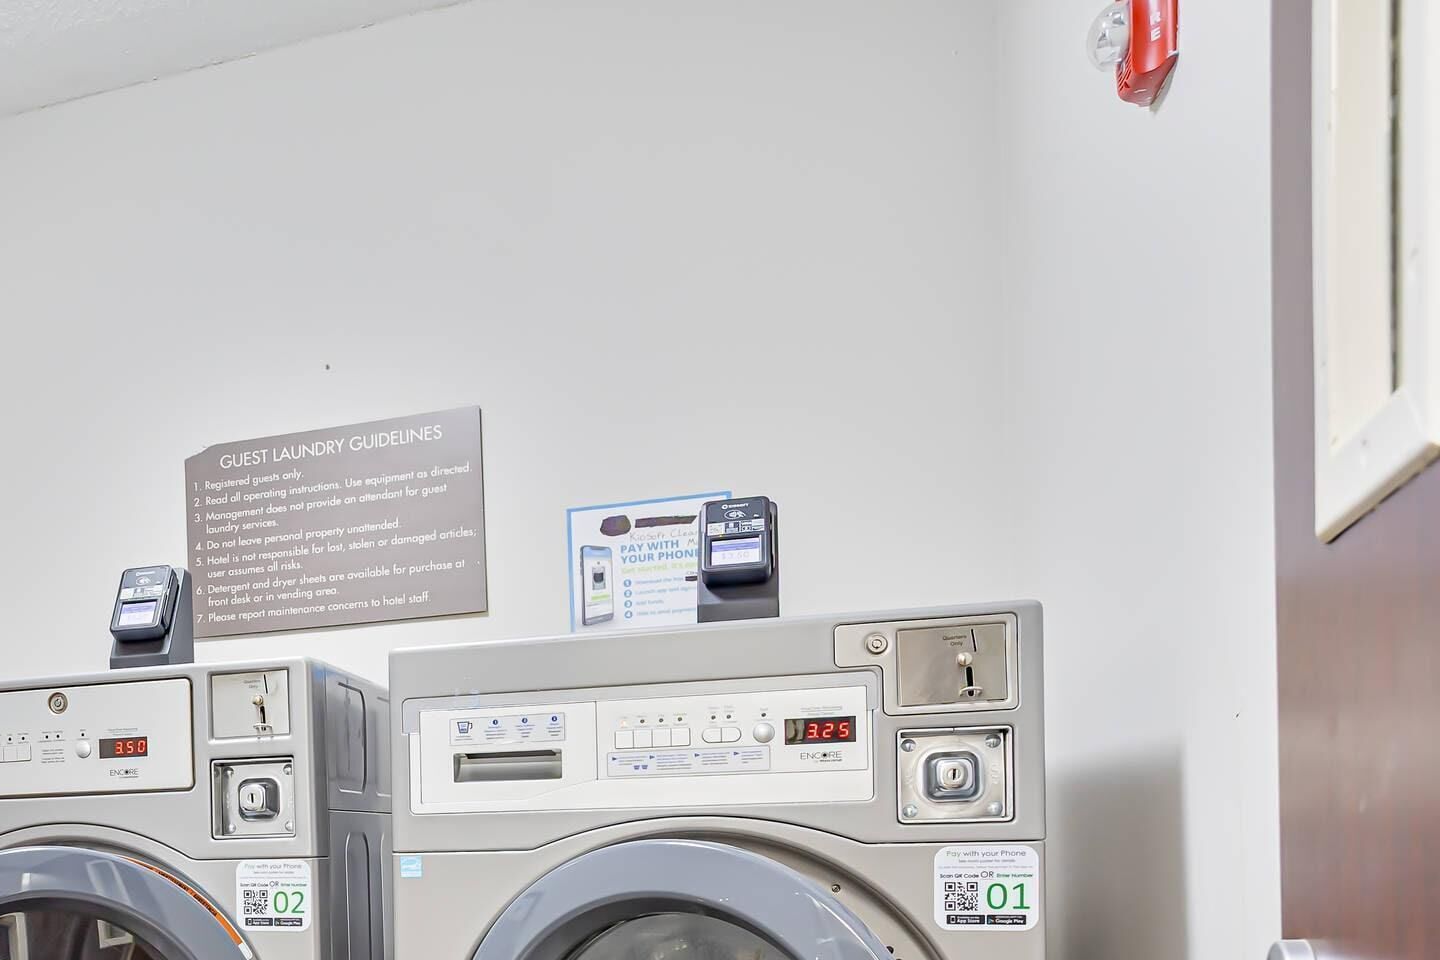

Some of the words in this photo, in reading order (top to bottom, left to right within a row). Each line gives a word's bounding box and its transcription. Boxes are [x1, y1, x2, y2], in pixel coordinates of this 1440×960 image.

[220, 449, 268, 469] GUEST
[273, 438, 345, 462] LAUNDRY
[349, 425, 443, 451] GUIDELINES
[193, 497, 202, 507] 2.
[205, 493, 228, 506] Read
[230, 491, 241, 503] all
[243, 486, 287, 502] operating
[289, 481, 342, 495] instructions.
[345, 478, 362, 488] Use
[365, 471, 414, 487] equipment
[416, 471, 428, 479] as
[430, 461, 472, 477] directed.
[194, 482, 202, 491] 1.
[205, 474, 250, 491] Registered
[252, 473, 280, 486] guests
[282, 468, 304, 481] only.
[194, 513, 203, 523] 3.
[205, 507, 264, 521] Management
[266, 503, 287, 514] does
[289, 501, 304, 511] not
[306, 496, 342, 511] provide
[344, 496, 357, 504] an
[359, 489, 403, 503] attendant
[405, 486, 419, 497] for
[421, 483, 447, 498] guest
[206, 521, 240, 535] laundry
[242, 519, 279, 530] services.
[195, 542, 204, 551] 4.
[206, 540, 220, 550] Do
[222, 538, 236, 548] not
[238, 536, 262, 546] leave
[264, 529, 303, 546] personal
[305, 526, 344, 541] property
[196, 557, 204, 567] 5.
[207, 553, 230, 566] Hotel
[232, 554, 240, 563] is
[242, 552, 256, 561] not
[258, 545, 309, 561] responsible
[311, 543, 324, 554] for
[327, 541, 346, 552] lost,
[348, 538, 375, 550] stolen
[377, 538, 389, 546] or
[391, 530, 437, 545] damaged
[439, 526, 477, 540] articles;
[620, 543, 644, 554] PAY
[647, 540, 679, 551] WITH
[207, 569, 226, 578] user
[228, 565, 265, 576] assumes
[267, 561, 278, 572] all
[280, 559, 303, 571] risks.
[621, 553, 655, 564] YOUR
[196, 586, 205, 595] 6.
[207, 582, 250, 595] Detergent
[252, 578, 270, 589] and
[272, 577, 297, 592] dryer
[299, 574, 327, 585] sheets
[329, 573, 345, 582] are
[347, 565, 390, 579] available
[393, 564, 406, 575] for
[408, 560, 453, 575] purchase
[455, 560, 465, 568] at
[196, 614, 205, 624] 7.
[208, 613, 236, 623] Please
[238, 609, 265, 621] report
[267, 604, 325, 617] maintenance
[327, 600, 368, 611] concerns
[371, 599, 380, 607] to
[383, 594, 406, 606] hotel
[408, 591, 431, 604] staff.
[208, 597, 229, 607] front
[231, 593, 251, 605] desk
[253, 595, 263, 603] or
[266, 592, 275, 601] in
[277, 588, 313, 600] vending
[807, 722, 849, 739] 3.25
[115, 740, 146, 755] 3.50
[800, 750, 843, 761] ENCORE
[109, 768, 139, 777] ENCORE
[946, 850, 961, 858] Pay
[273, 891, 305, 914] 02
[986, 882, 1030, 910] 01
